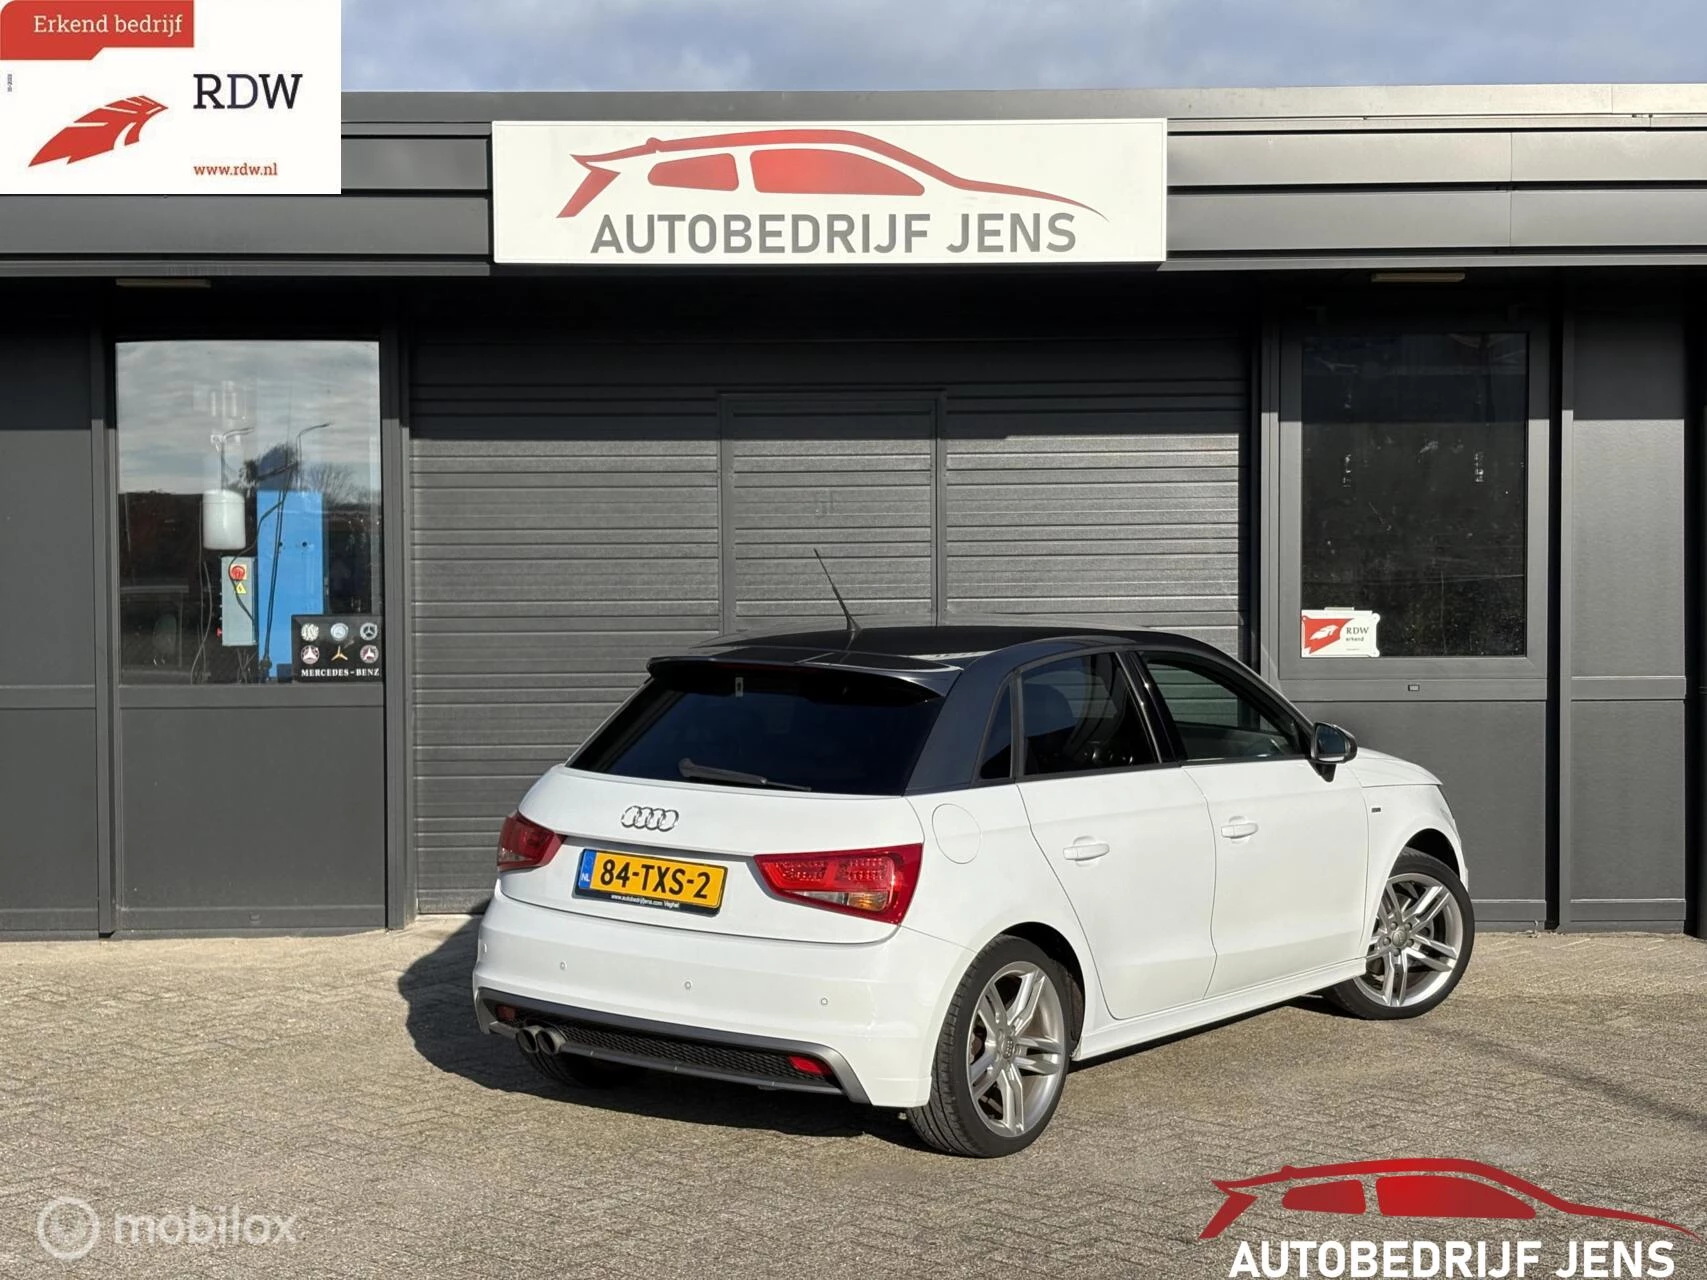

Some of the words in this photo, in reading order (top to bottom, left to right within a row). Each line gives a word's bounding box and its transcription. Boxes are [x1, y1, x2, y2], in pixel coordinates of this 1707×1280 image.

[590, 213, 931, 254] AUTOBEDRIJF
[946, 212, 1076, 254] JENS
[1346, 626, 1369, 635] RDW
[600, 858, 711, 899] 84-TXS-2
